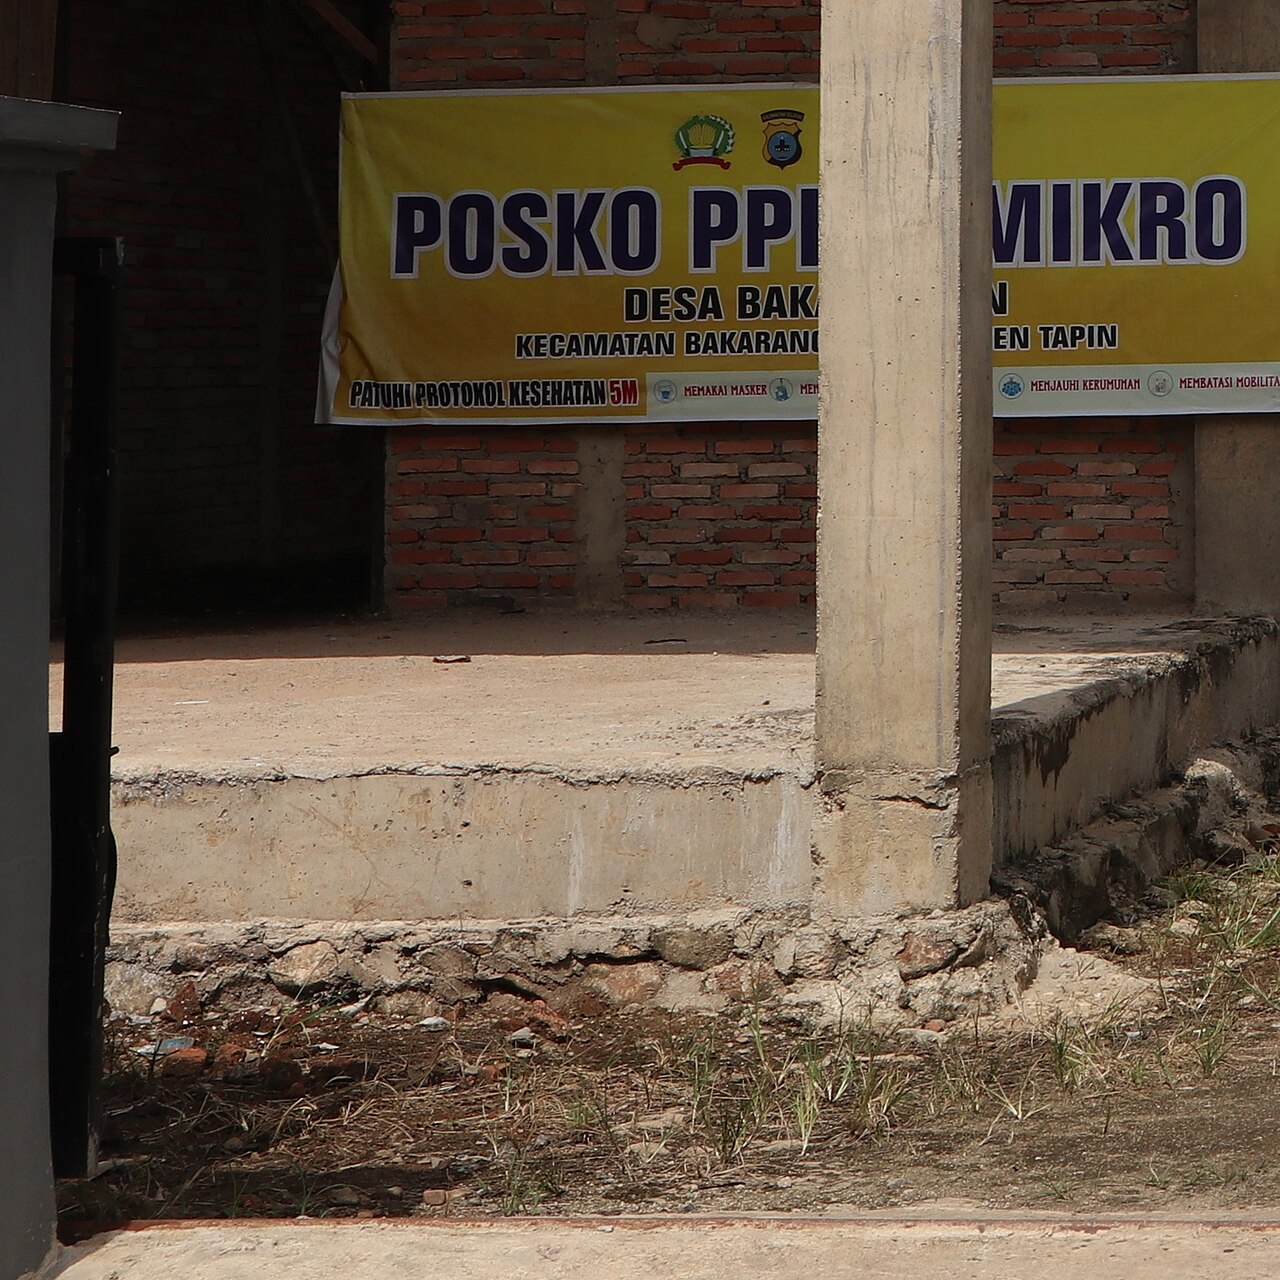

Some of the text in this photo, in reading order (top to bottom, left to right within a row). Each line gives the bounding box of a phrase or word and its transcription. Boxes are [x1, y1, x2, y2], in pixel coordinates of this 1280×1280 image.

[391, 186, 660, 278] POSKO
[993, 174, 1246, 267] MIKRO
[624, 285, 723, 322] DESA
[515, 331, 676, 359] KECAMATAN
[1038, 323, 1119, 350] TAPIN
[350, 380, 639, 409] PATUHI PROTOKOL KESEHATAN 5M
[684, 384, 768, 397] MEMAKAI MASKER
[1030, 379, 1141, 392] MENJAUHI KERUMUNAN
[1179, 377, 1233, 390] MEMBATASI
